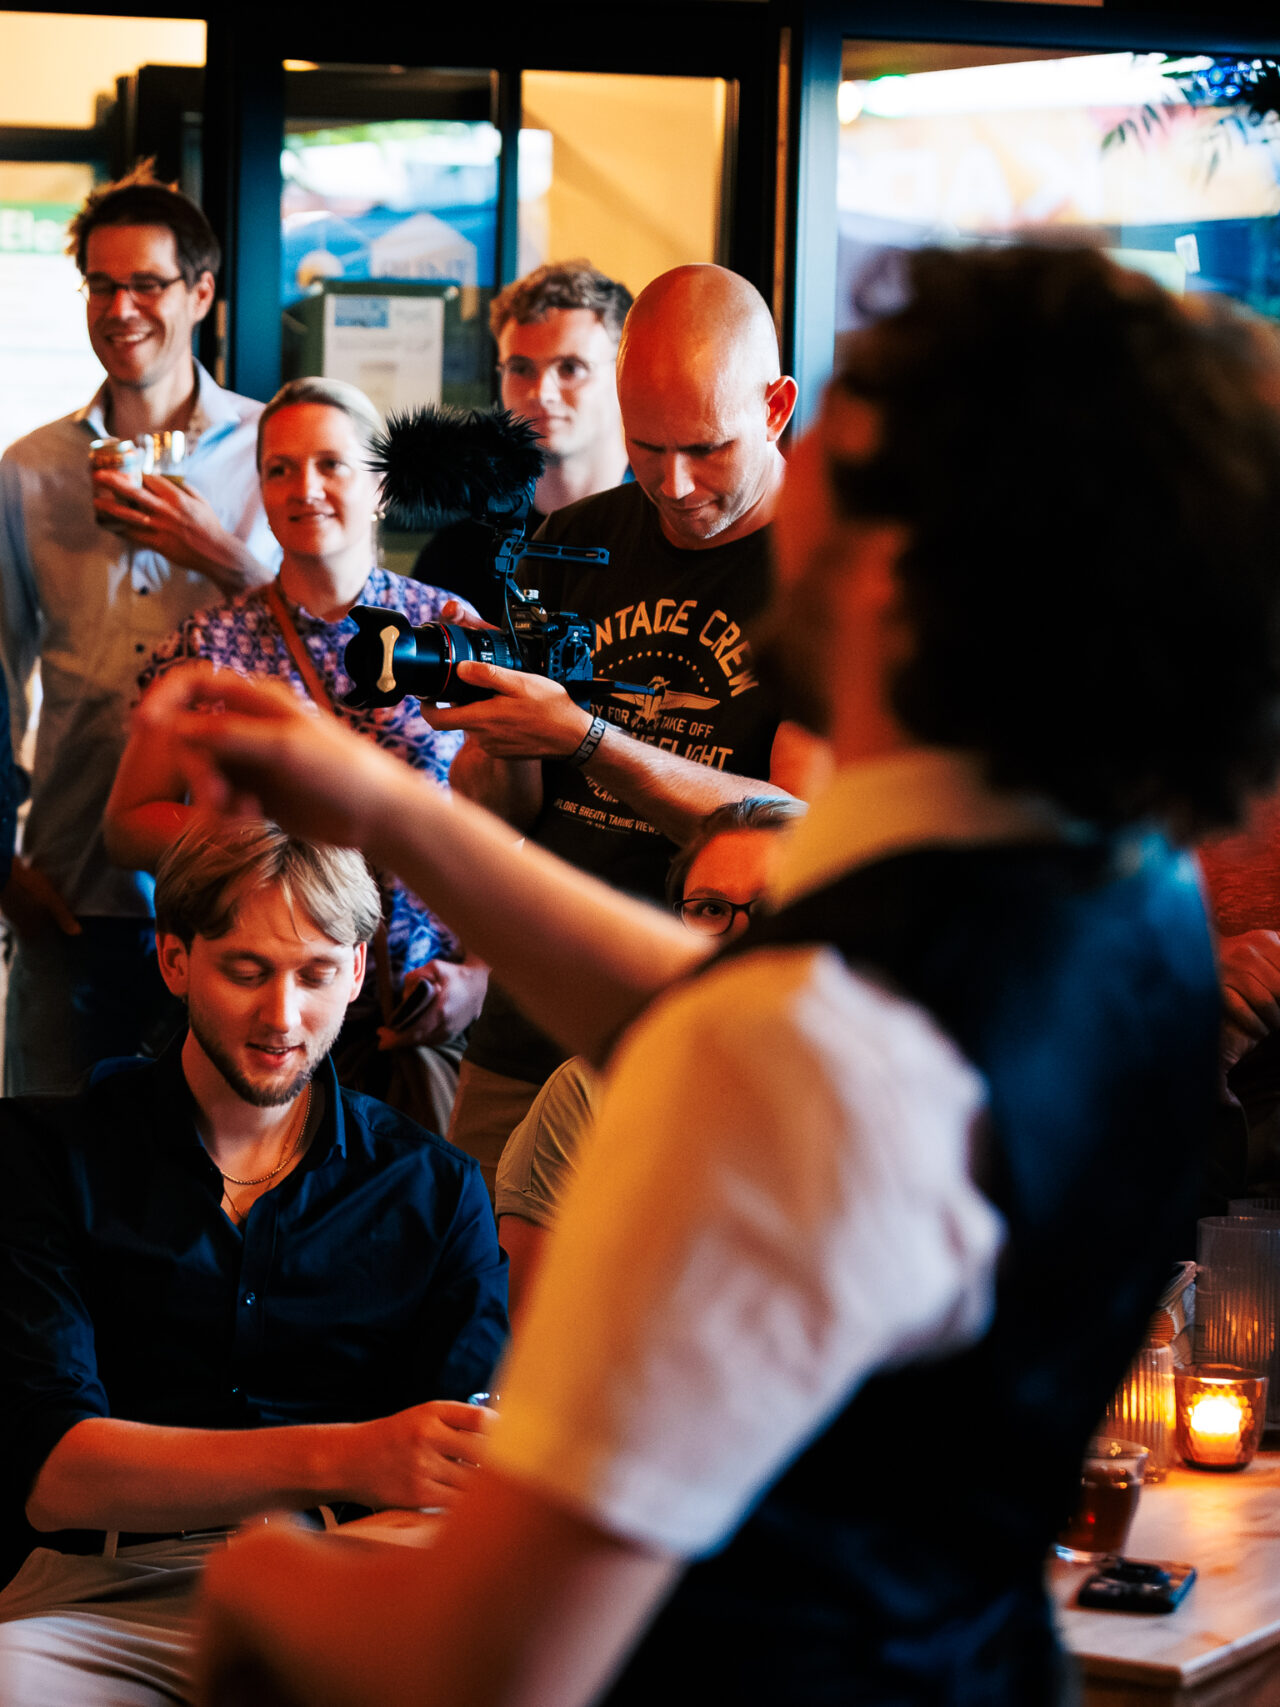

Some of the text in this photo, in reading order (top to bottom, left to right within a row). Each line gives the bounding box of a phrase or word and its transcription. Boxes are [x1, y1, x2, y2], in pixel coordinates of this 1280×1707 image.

[590, 599, 759, 697] NTAGE CREW
[608, 706, 630, 725] FOR
[688, 722, 714, 738] OFF
